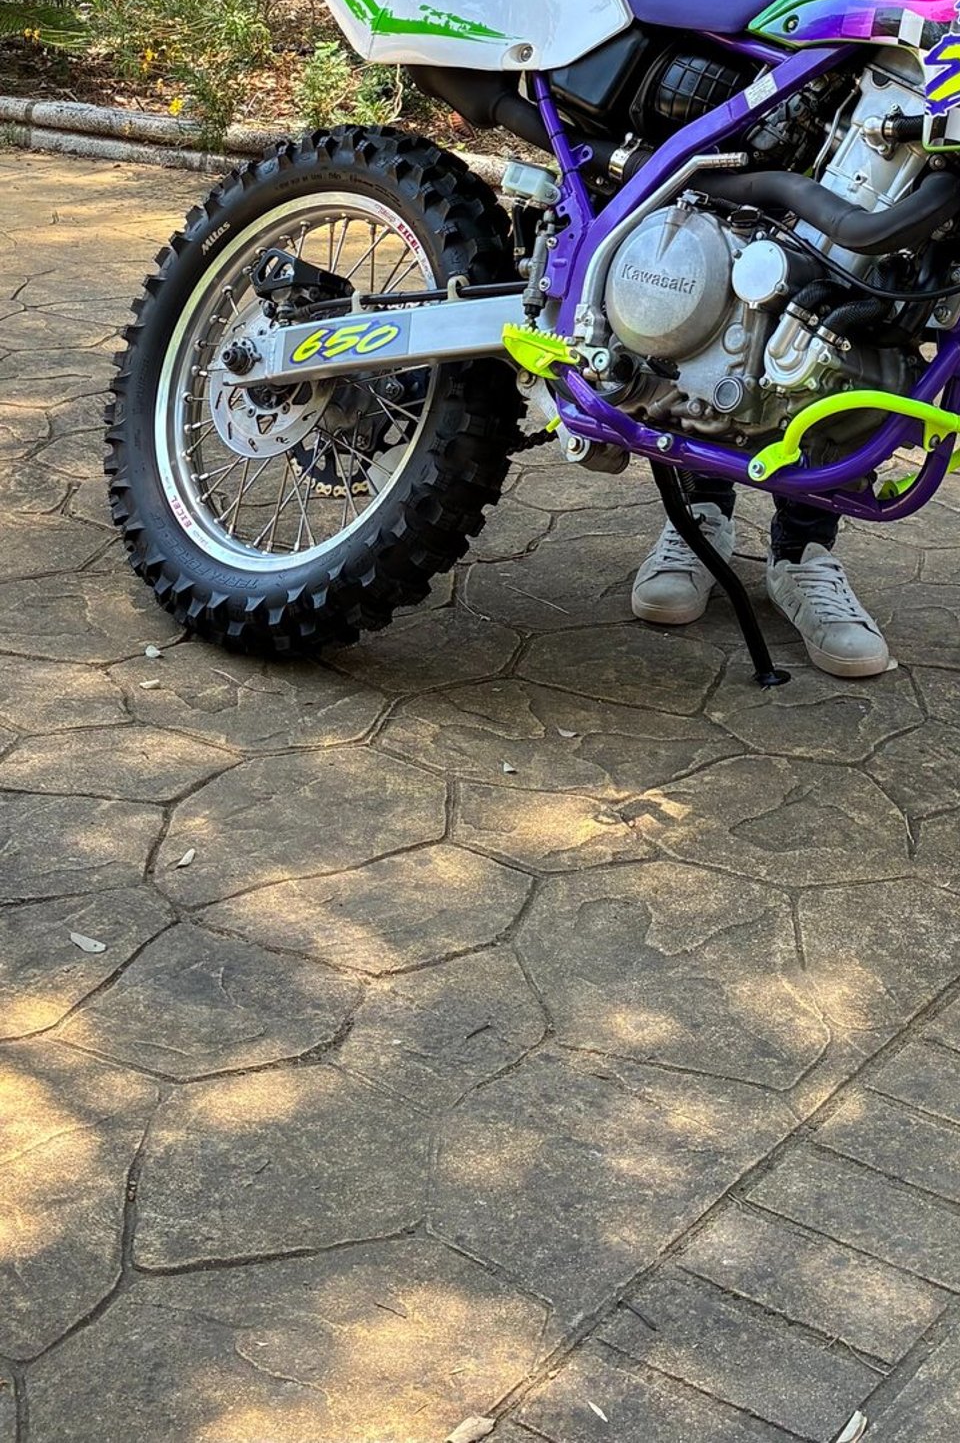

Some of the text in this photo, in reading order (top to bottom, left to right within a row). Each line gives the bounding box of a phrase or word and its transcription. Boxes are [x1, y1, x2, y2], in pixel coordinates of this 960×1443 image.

[201, 221, 231, 256] Mitas
[396, 222, 422, 255] EXCEL
[621, 263, 697, 295] Kawasaki
[290, 321, 401, 363] 650
